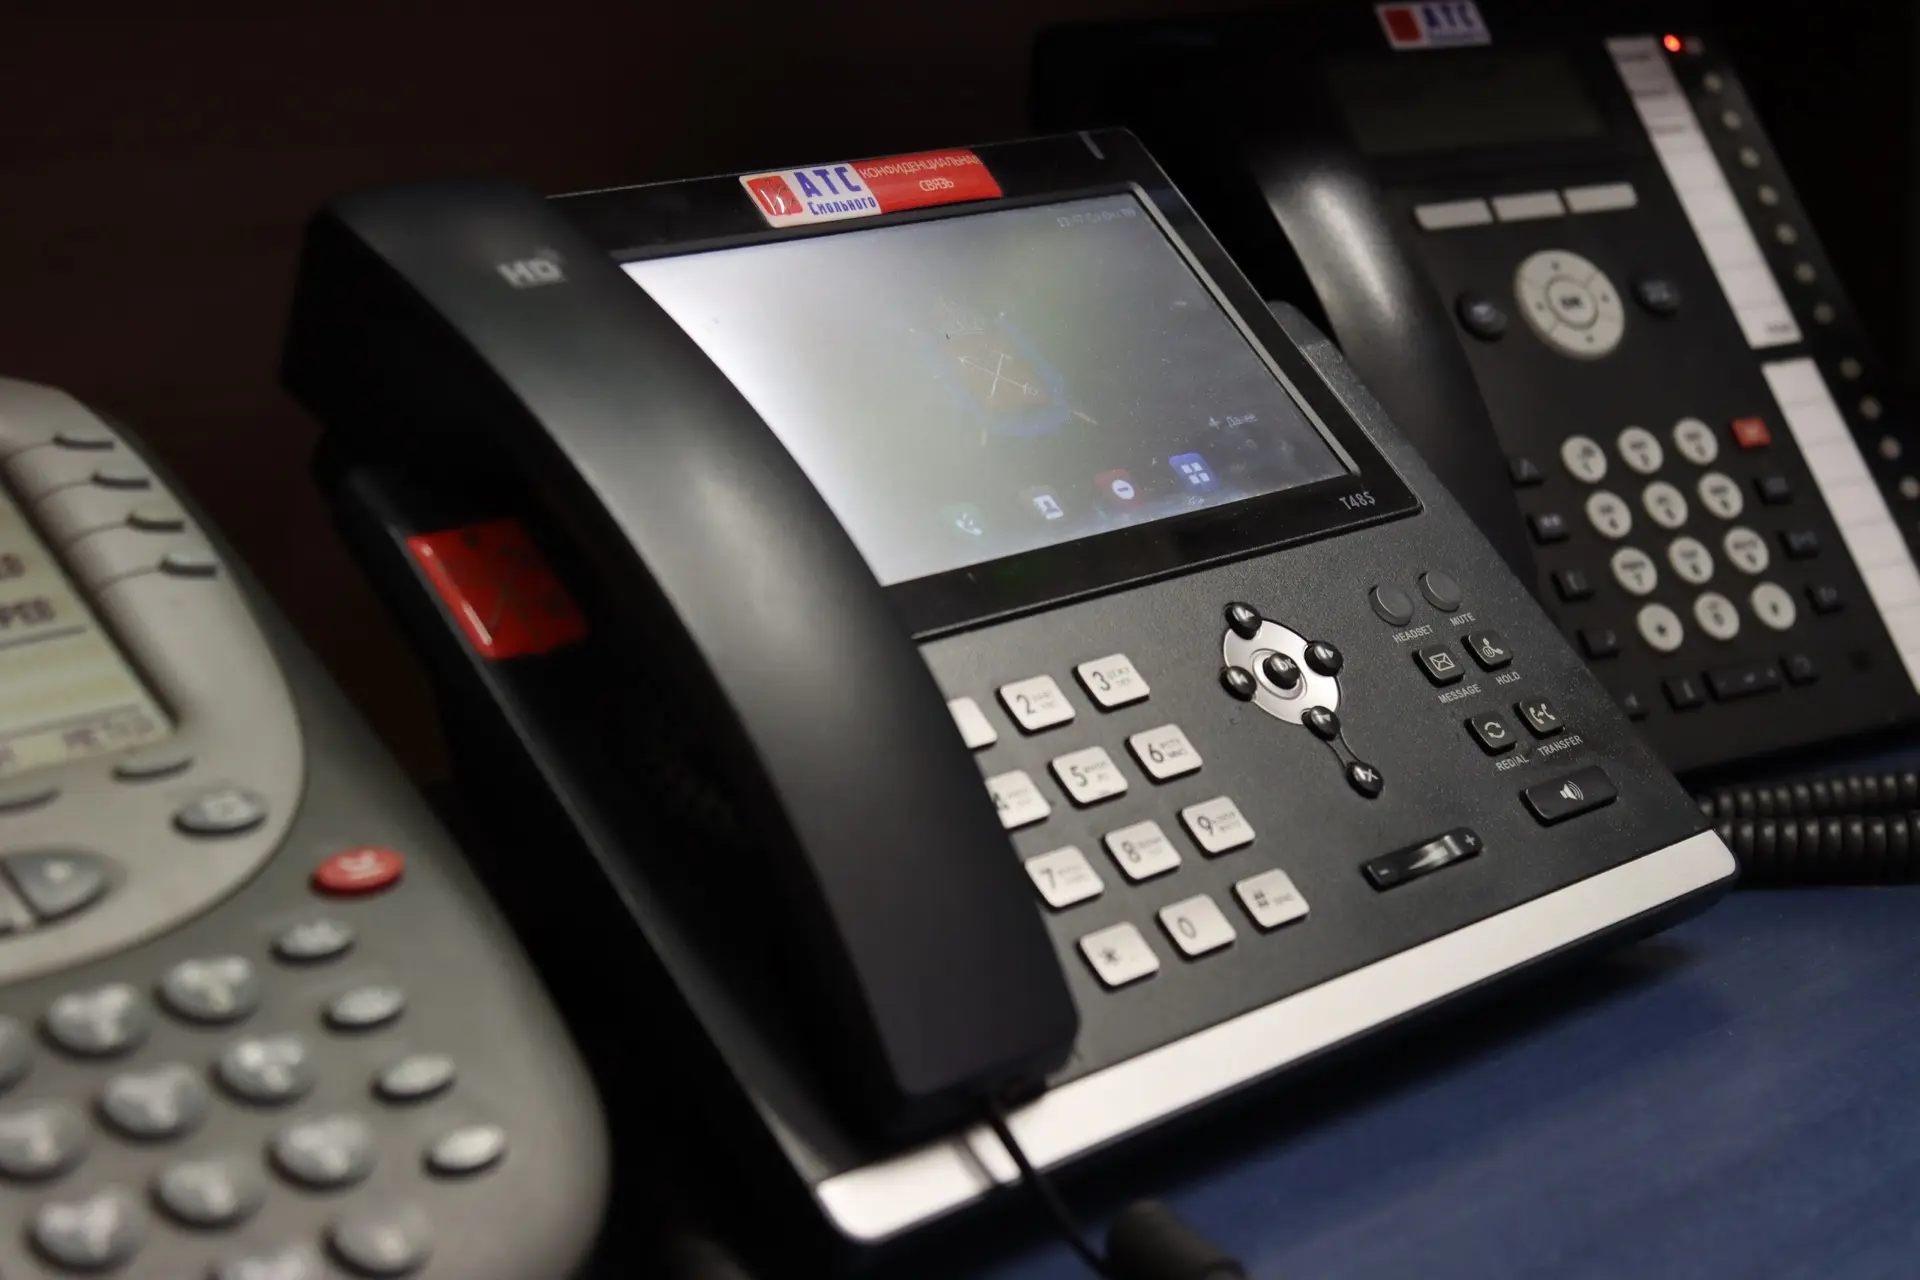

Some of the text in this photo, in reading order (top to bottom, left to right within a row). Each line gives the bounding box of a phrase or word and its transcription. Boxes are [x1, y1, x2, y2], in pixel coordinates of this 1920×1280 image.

[794, 166, 861, 198] АТС
[919, 177, 954, 192] СВЯЗЬ
[1339, 491, 1376, 510] T48S
[1450, 612, 1476, 627] MUTE
[1392, 624, 1434, 644] HEADSET
[1092, 670, 1111, 691] 3
[1495, 671, 1521, 686] HOLD
[1438, 683, 1482, 704] MESSAGE
[1016, 694, 1036, 714] 2
[1148, 743, 1165, 763] 6
[1537, 734, 1583, 757] TRANSFER
[1495, 754, 1530, 772] REDIAL
[1070, 764, 1088, 787] 5
[1197, 816, 1214, 836] 9
[1121, 840, 1141, 863] 8
[1040, 868, 1056, 890] 7
